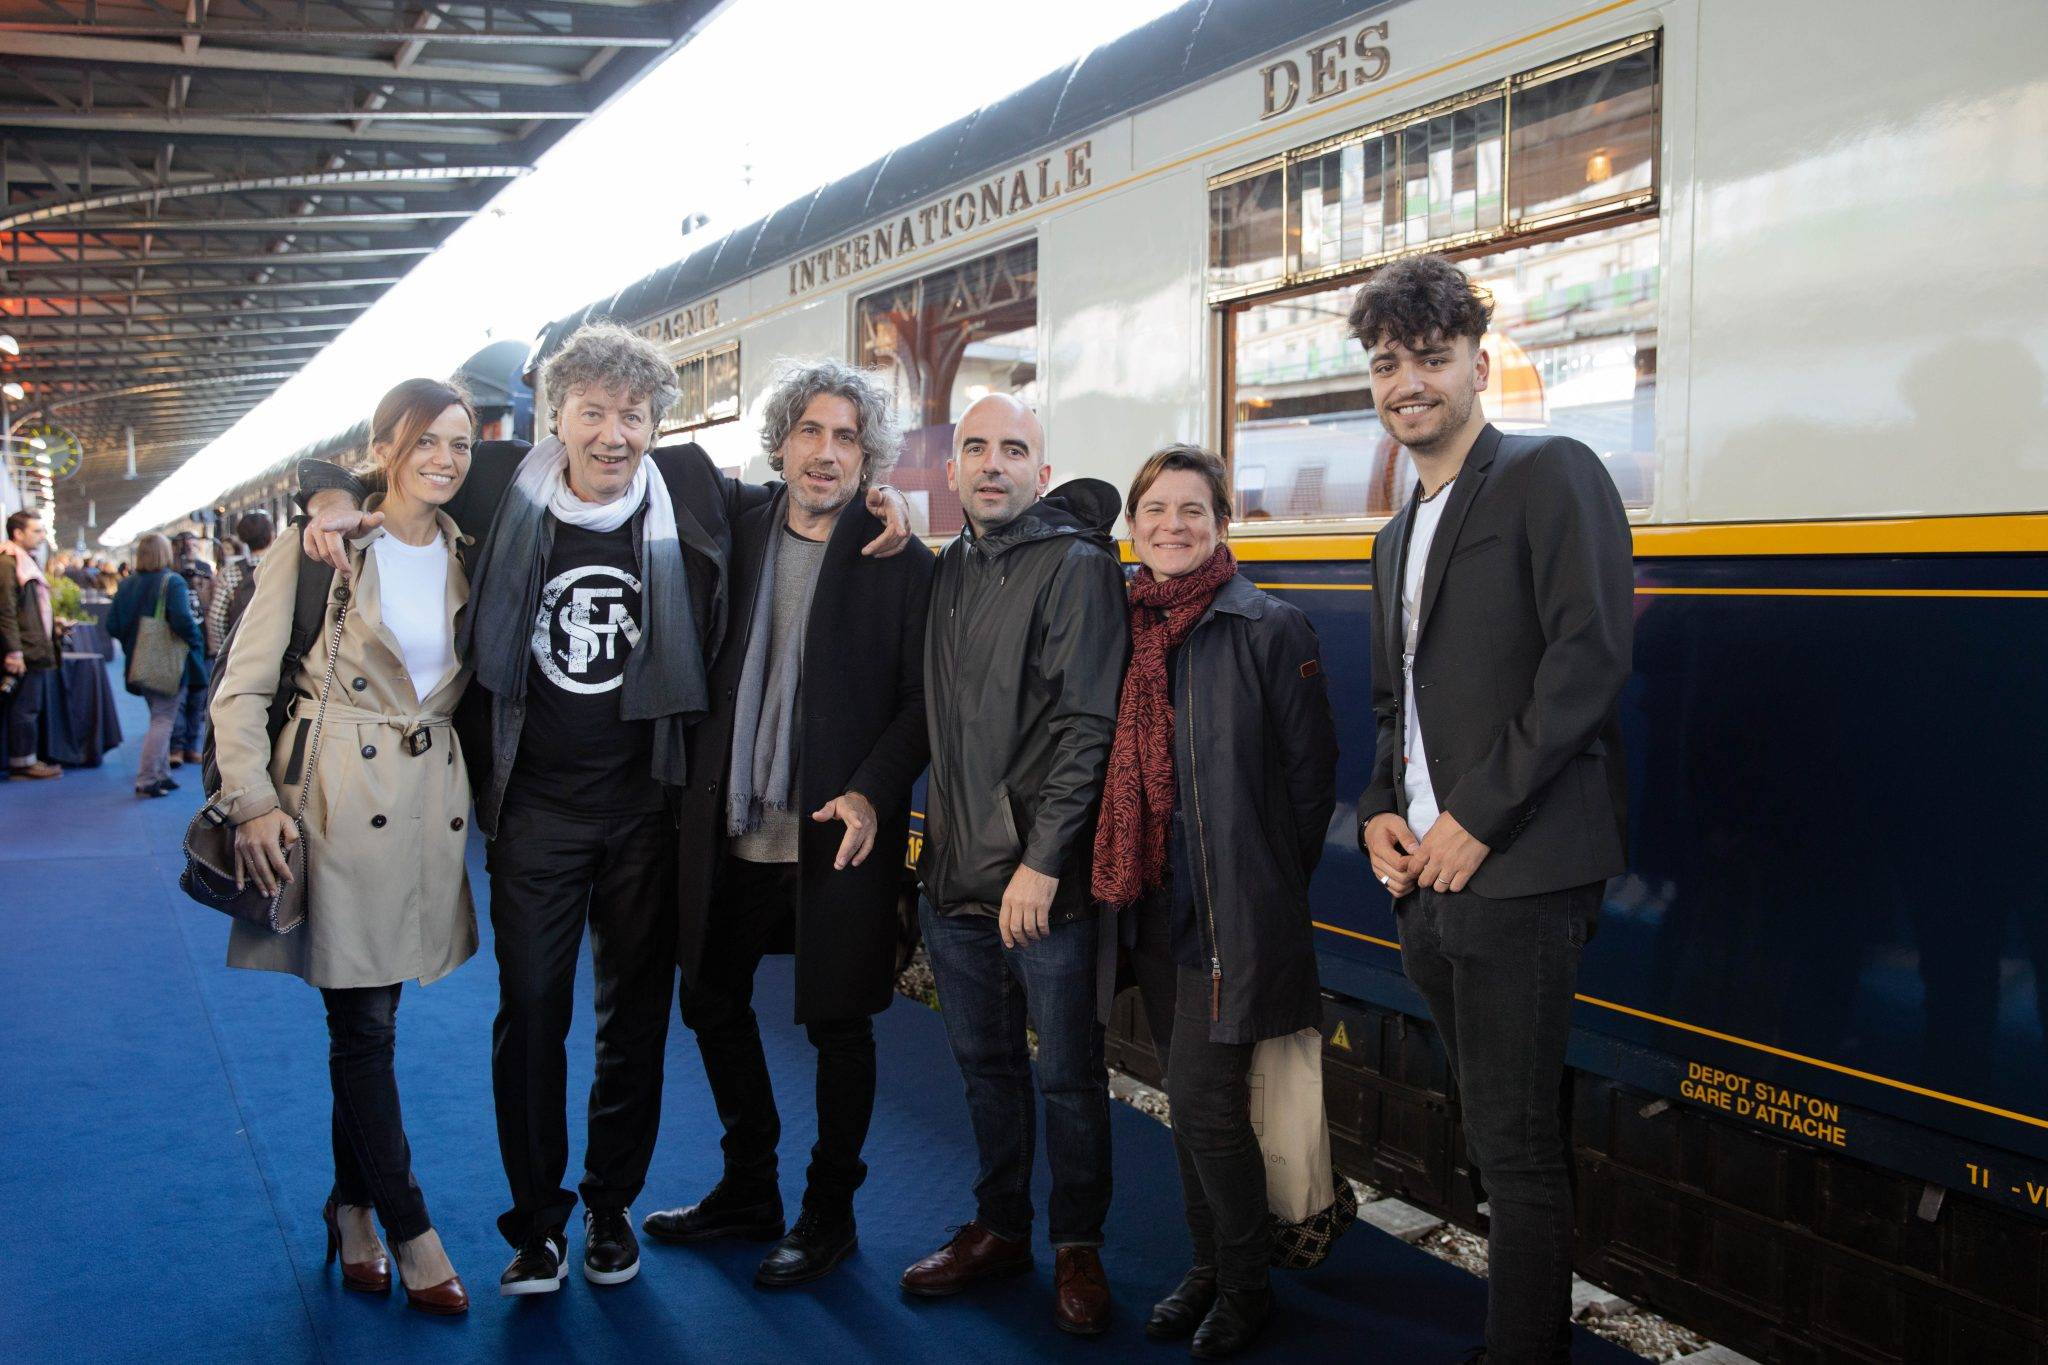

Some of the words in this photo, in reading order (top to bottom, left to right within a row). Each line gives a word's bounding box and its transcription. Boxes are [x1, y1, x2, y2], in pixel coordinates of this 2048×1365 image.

[788, 140, 1092, 296] INTERNATIONALE
[1259, 20, 1390, 120] DES
[1680, 1080, 1732, 1110] GARE
[1737, 1097, 1846, 1146] D'ATTACHE
[1688, 1062, 1750, 1094] DEPOT
[1755, 1082, 1839, 1122] STATON
